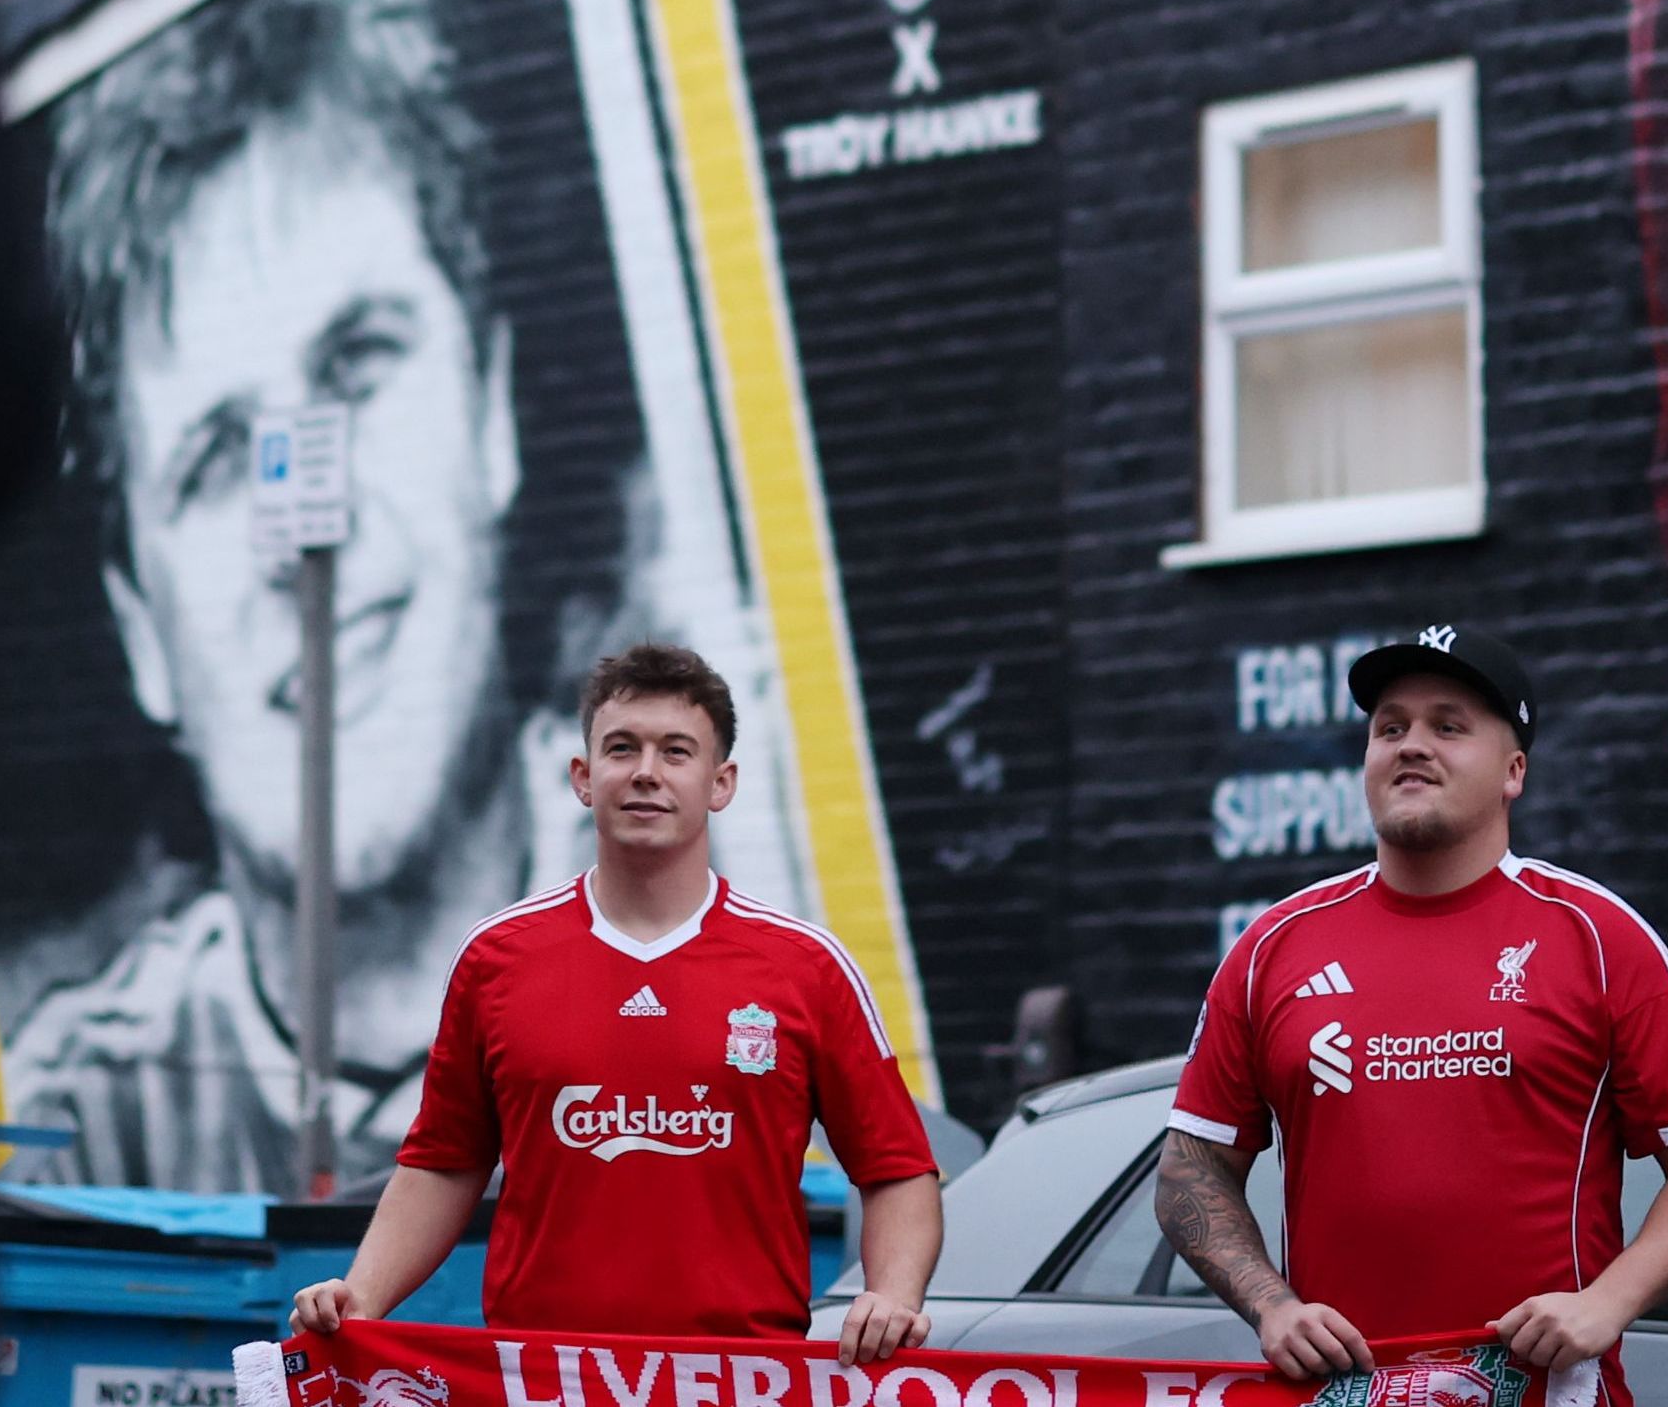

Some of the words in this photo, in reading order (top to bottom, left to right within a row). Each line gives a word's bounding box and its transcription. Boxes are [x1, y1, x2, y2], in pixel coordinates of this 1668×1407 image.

[890, 19, 941, 94] X
[1419, 625, 1457, 654] NY
[1237, 645, 1325, 731] FOR
[1489, 987, 1528, 1003] L.F.C.
[619, 1005, 668, 1017] adidas
[1366, 1027, 1503, 1057] standard
[1365, 1052, 1512, 1081] chartered
[552, 1084, 734, 1163] Carlsberg
